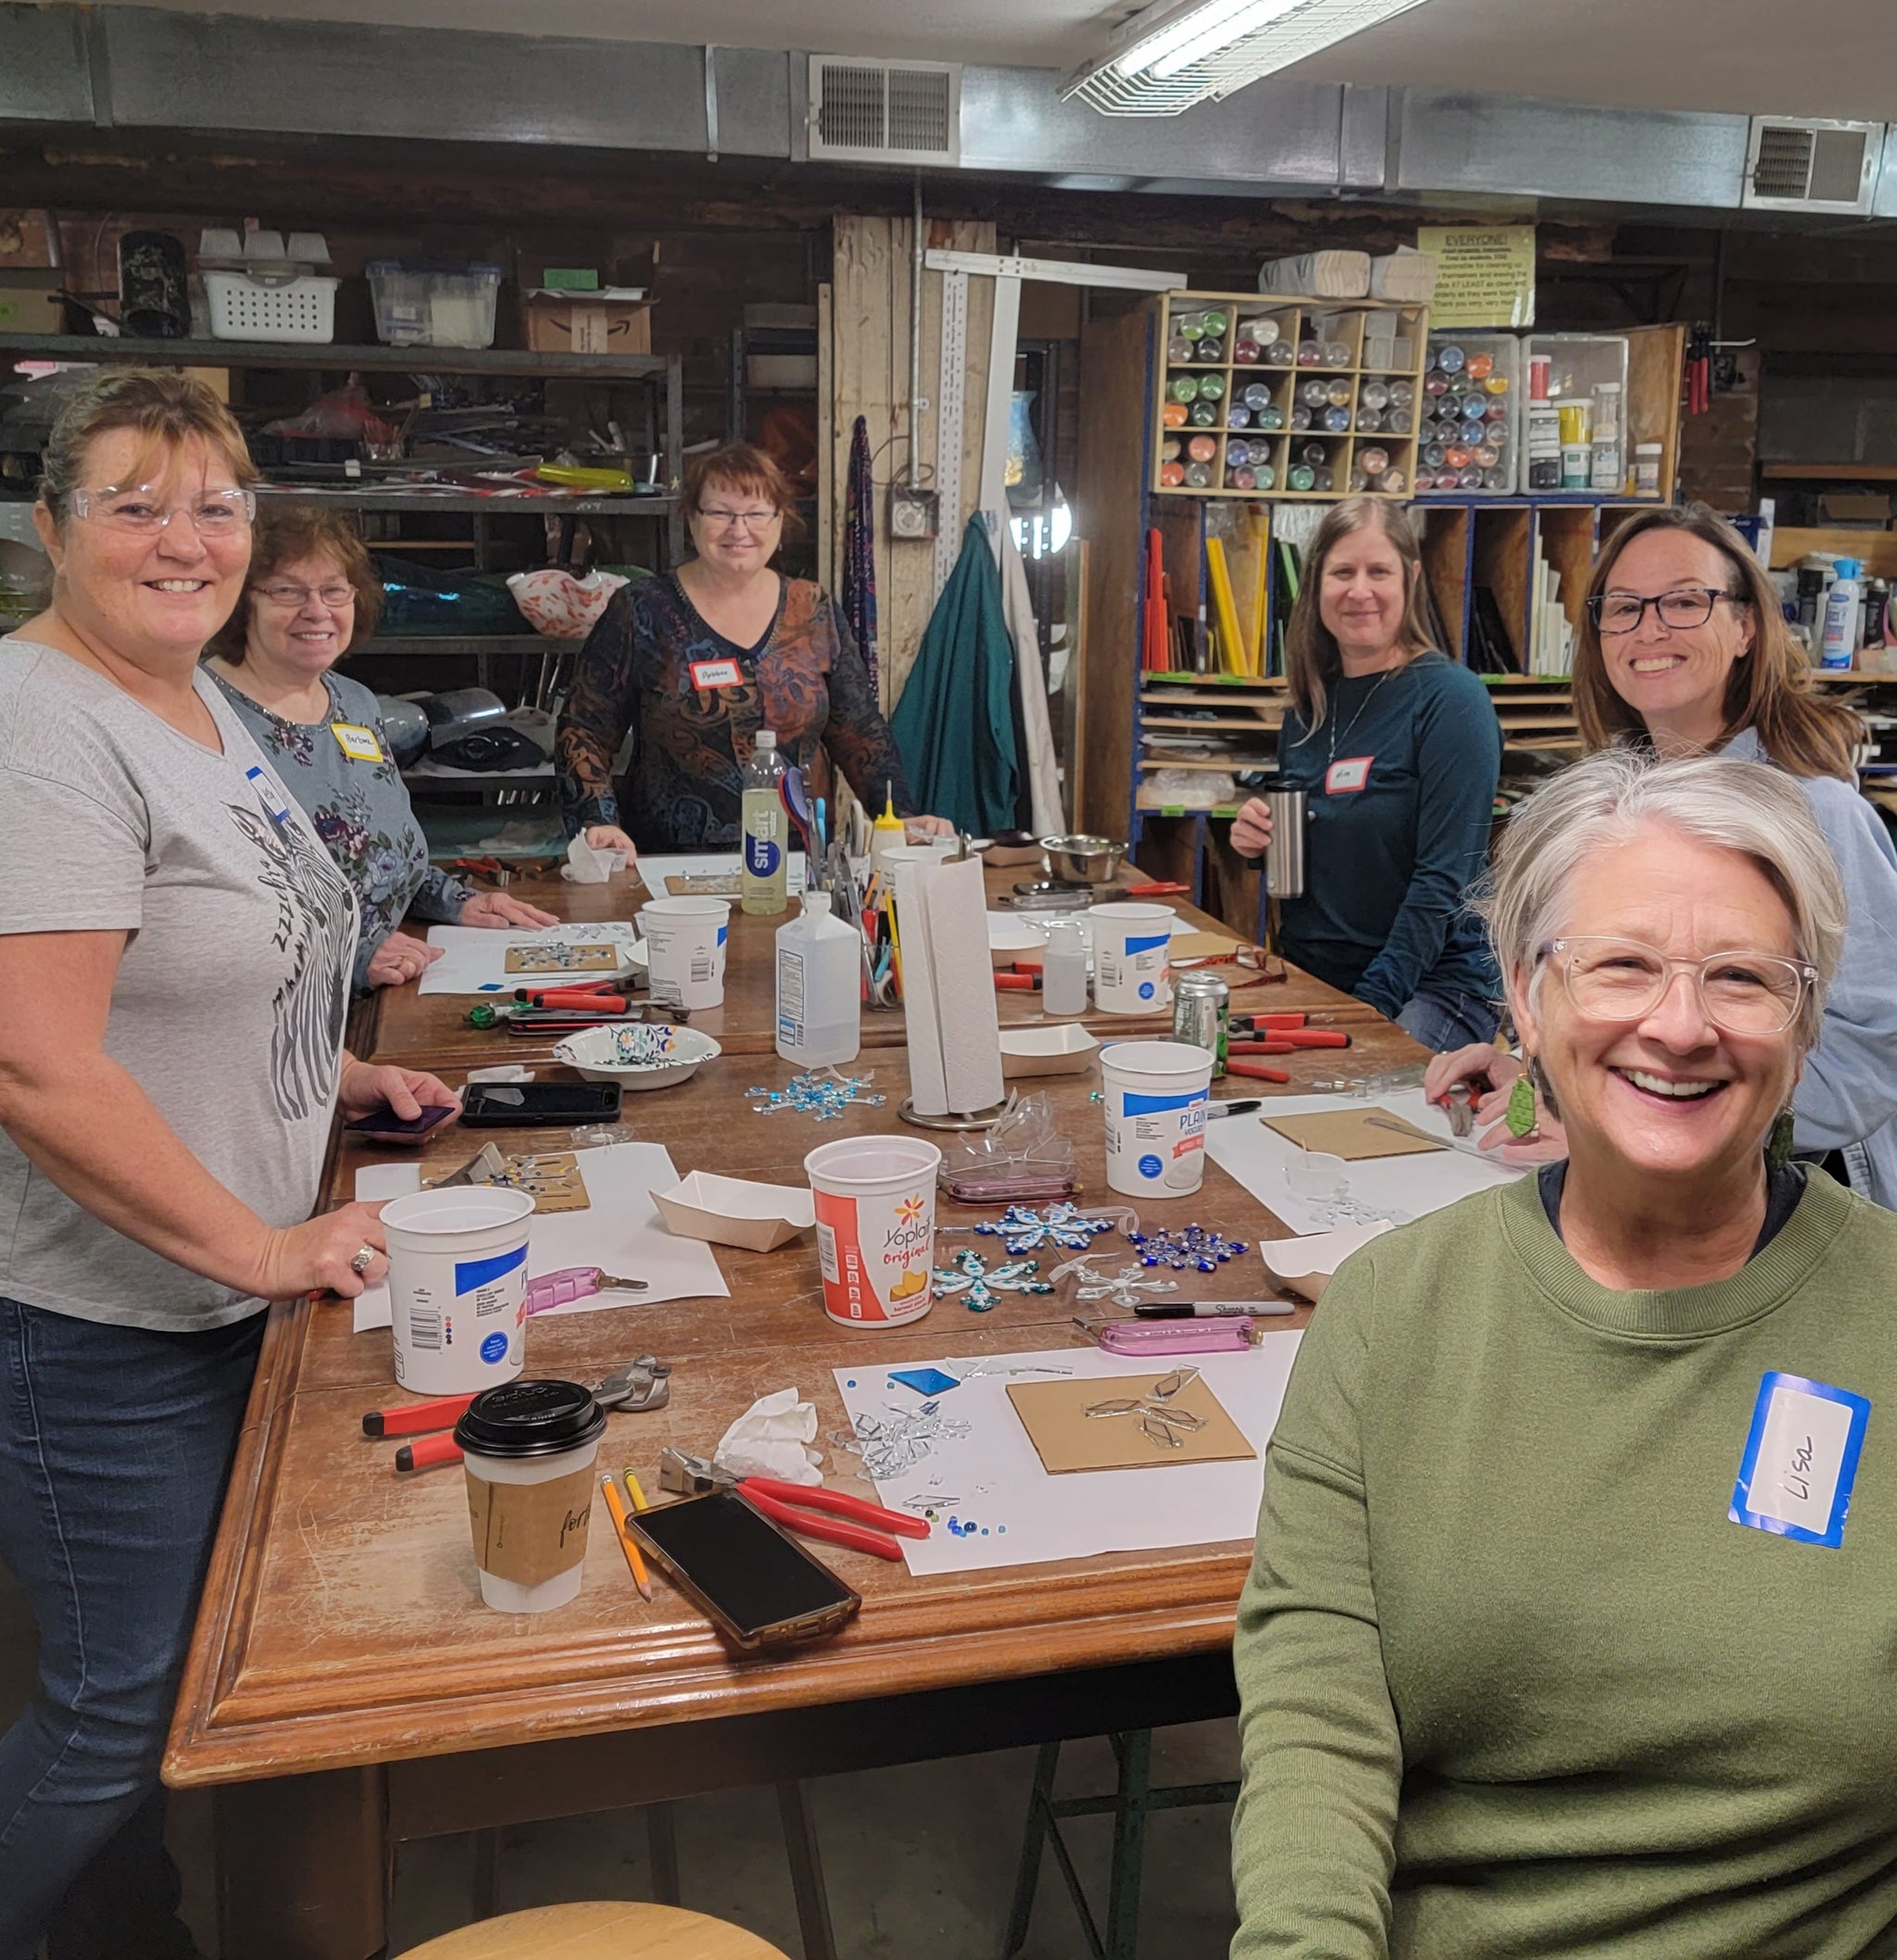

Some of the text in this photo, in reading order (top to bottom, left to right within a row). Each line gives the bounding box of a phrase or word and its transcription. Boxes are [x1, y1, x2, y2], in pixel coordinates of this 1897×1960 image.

[753, 810, 770, 870] smart
[883, 1216, 933, 1250] Yoplait
[883, 1235, 930, 1270] original
